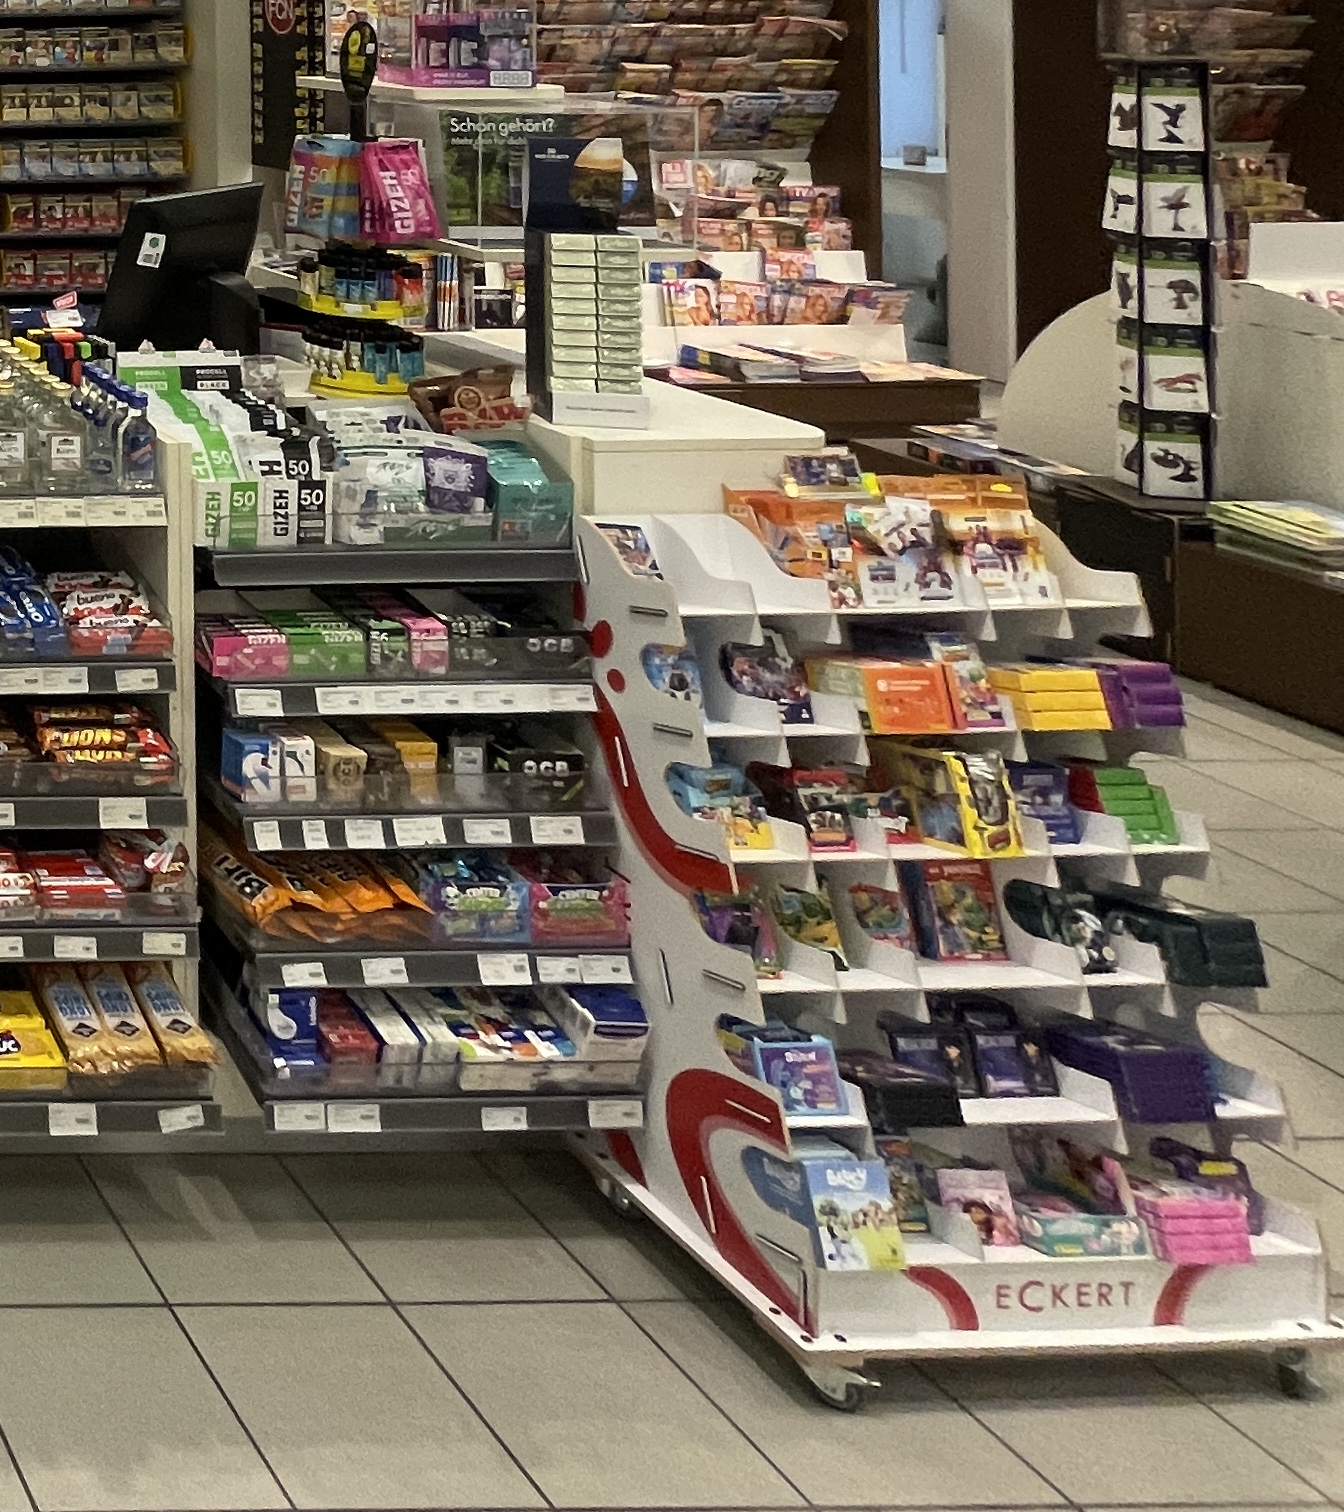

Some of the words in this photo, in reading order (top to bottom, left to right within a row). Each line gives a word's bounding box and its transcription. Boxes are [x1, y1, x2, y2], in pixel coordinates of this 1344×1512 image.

[268, 0, 294, 21] FCN
[450, 118, 495, 132] Schon
[499, 118, 555, 136] gehört?
[379, 171, 415, 234] GIZEH
[213, 451, 232, 464] 50
[289, 461, 309, 474] 50
[233, 492, 256, 506] 50
[300, 490, 323, 505] 50
[205, 492, 221, 537] GIZEH
[274, 490, 289, 536] GIZEH
[76, 592, 115, 605] bueno
[526, 638, 573, 653] OCB
[523, 761, 570, 775] OCB
[996, 1281, 1135, 1314] ECKERT
